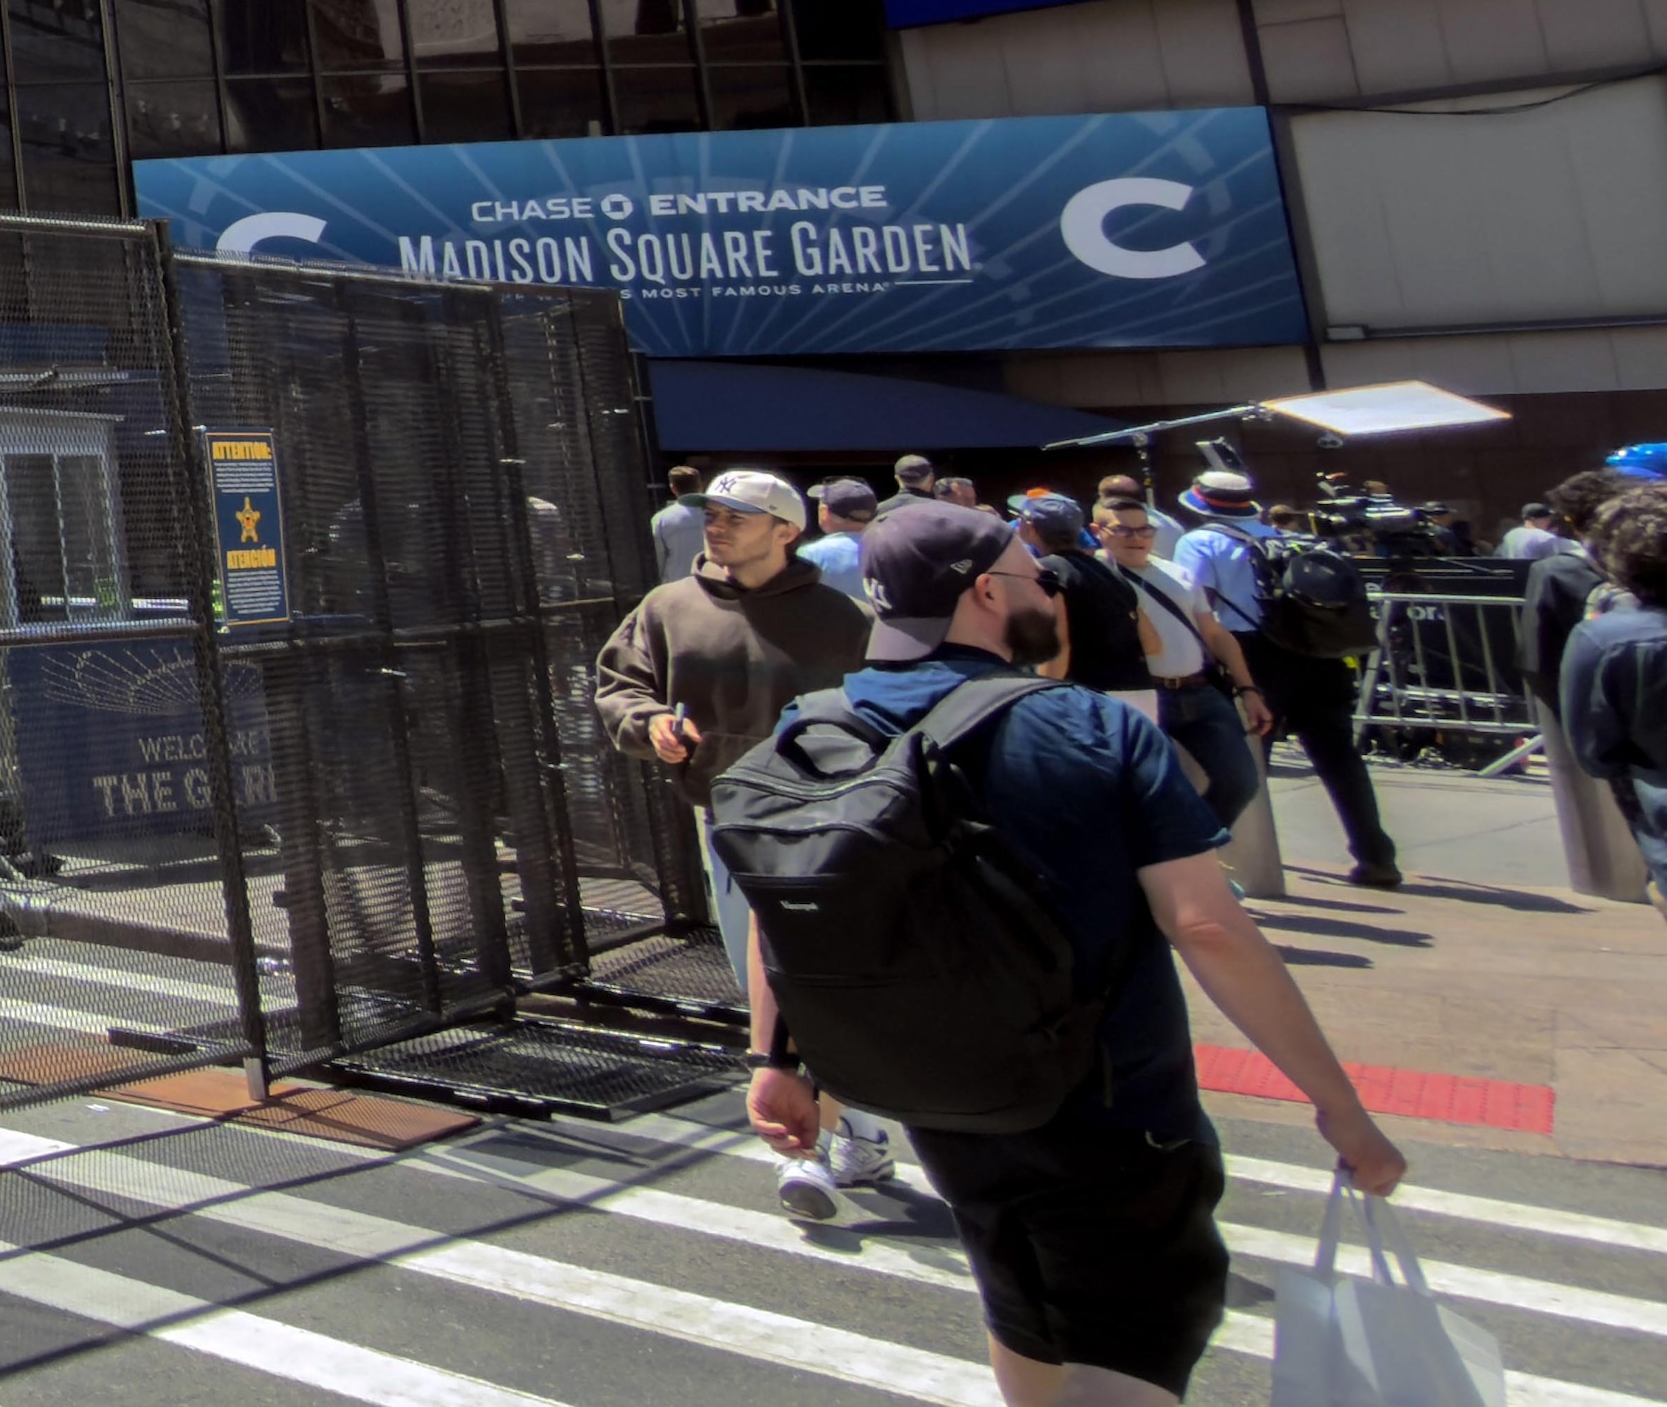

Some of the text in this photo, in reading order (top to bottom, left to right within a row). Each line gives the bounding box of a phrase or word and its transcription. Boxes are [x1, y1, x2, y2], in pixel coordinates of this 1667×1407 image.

[471, 186, 887, 222] CHASE ENTRANCE
[1061, 177, 1206, 278] C
[398, 236, 593, 283] MADISON
[607, 227, 778, 285] SQUARE
[643, 288, 701, 299] MOST
[713, 284, 801, 297] FAMOUS
[93, 771, 177, 817] THE
